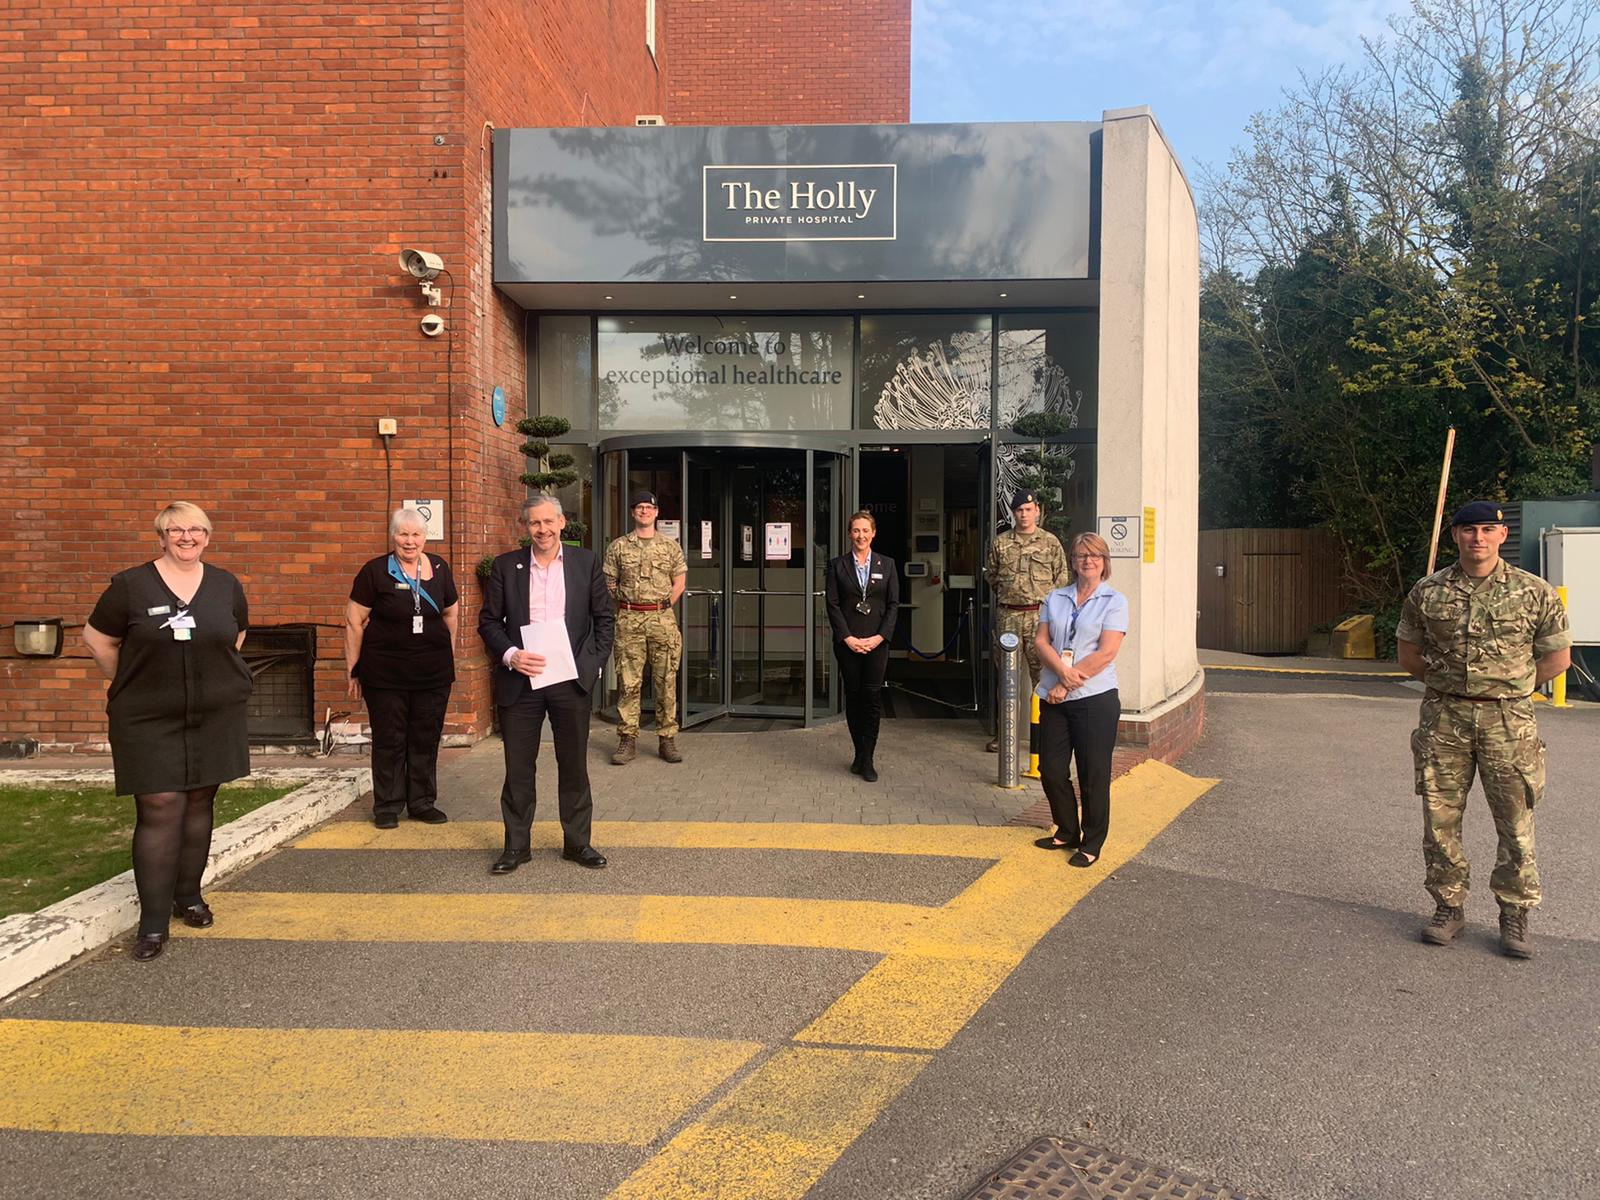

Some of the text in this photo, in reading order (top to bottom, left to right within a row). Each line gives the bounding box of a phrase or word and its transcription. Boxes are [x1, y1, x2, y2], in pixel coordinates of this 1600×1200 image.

[721, 181, 877, 218] The Holly
[745, 215, 854, 224] PRIVATE HOSPITAL
[662, 335, 786, 355] Welcome to
[606, 365, 842, 389] exceptional healthcare
